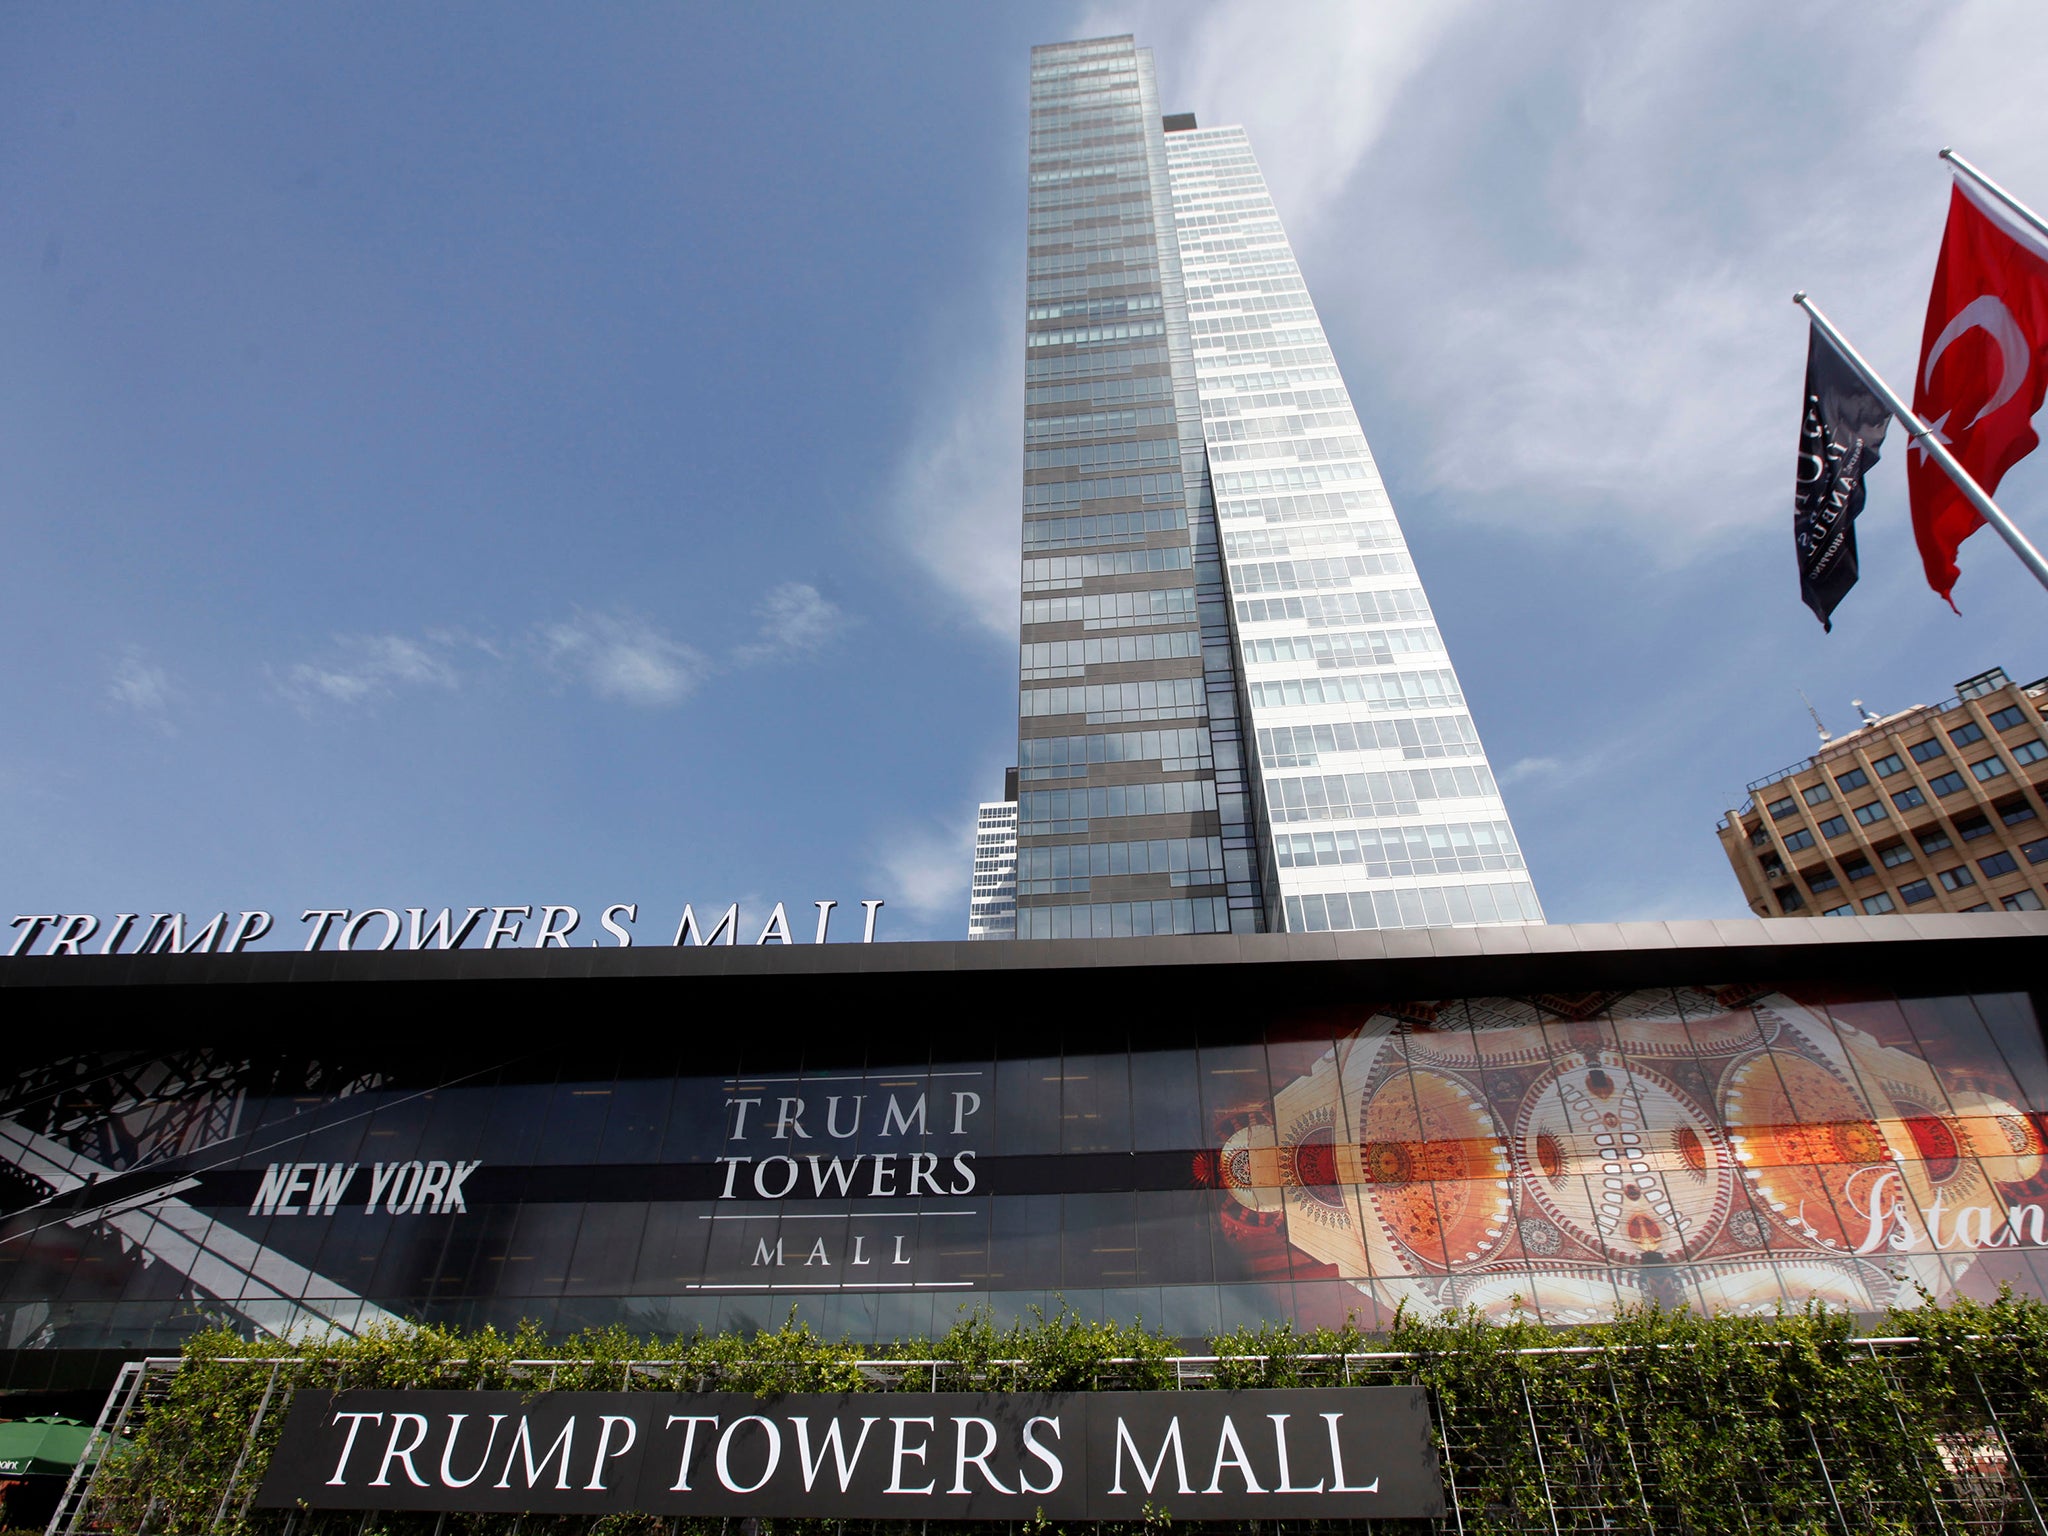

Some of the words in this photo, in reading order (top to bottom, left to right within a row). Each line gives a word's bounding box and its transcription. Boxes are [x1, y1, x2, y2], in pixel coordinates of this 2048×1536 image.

[8, 910, 273, 955] TRUMP
[725, 1091, 981, 1140] TRUMP
[248, 1162, 360, 1216] NEW
[364, 1160, 483, 1216] YORK
[715, 1150, 976, 1199] TOWERS
[751, 1235, 911, 1267] MALL
[324, 1411, 637, 1490] TRUMP
[665, 1414, 1064, 1495] TOWERS
[1107, 1413, 1379, 1495] MALL
